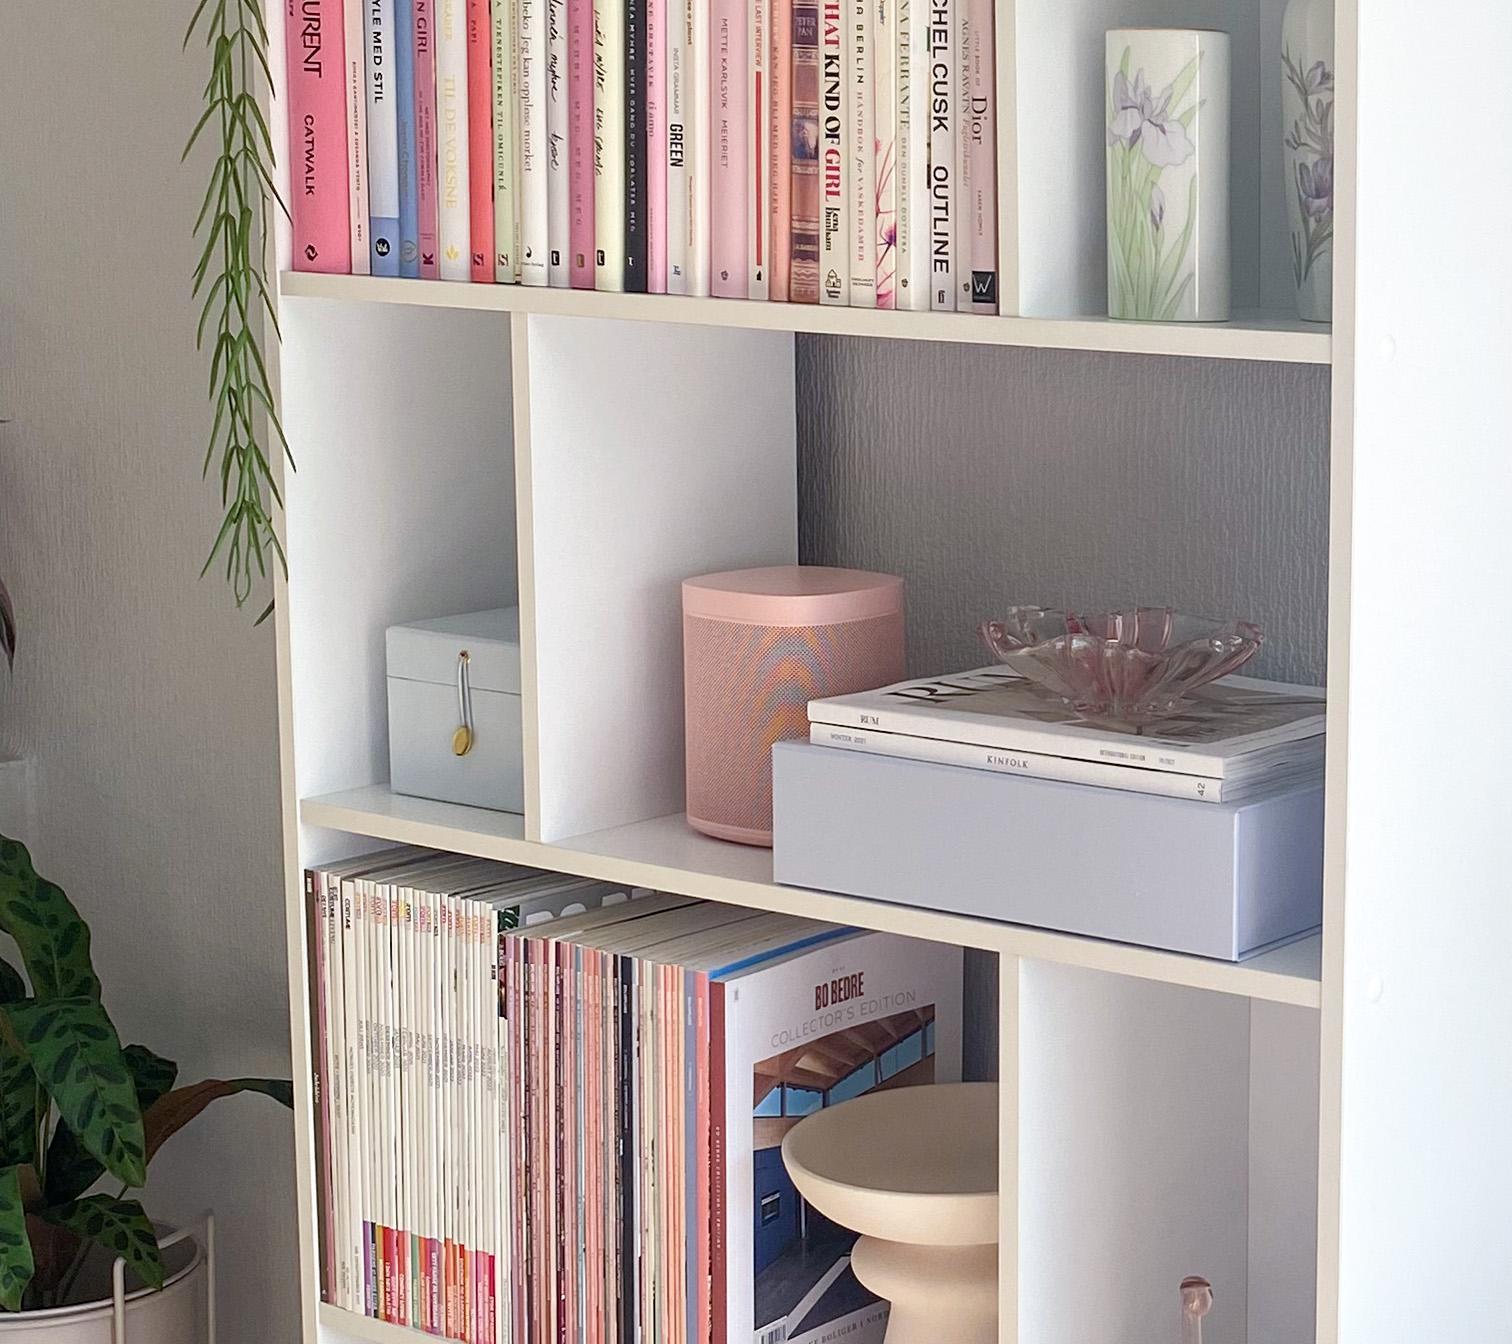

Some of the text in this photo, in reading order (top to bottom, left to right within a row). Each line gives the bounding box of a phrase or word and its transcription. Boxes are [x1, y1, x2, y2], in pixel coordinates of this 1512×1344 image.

[416, 17, 428, 58] GIRL
[686, 21, 694, 46] plant
[755, 6, 763, 26] LAST
[799, 26, 814, 37] PAN
[373, 30, 383, 66] MED
[521, 36, 533, 54] Jeg
[755, 26, 763, 67] INTERVIEW
[855, 23, 865, 84] BERLIN
[961, 18, 970, 61] AGNES
[374, 72, 384, 104] STIL
[523, 57, 533, 78] kan
[824, 53, 841, 112] KIND
[900, 31, 911, 131] FERRANTE
[961, 64, 971, 114] RAVATN
[720, 17, 729, 169] METTE KARLSVIK MEIERIET
[932, 63, 949, 133] CUSK
[630, 133, 636, 147] DU
[825, 115, 841, 146] OF
[972, 96, 989, 146] Dior
[304, 114, 316, 197] CATWALK
[669, 123, 684, 168] GREEN
[856, 156, 865, 173] for
[446, 137, 458, 209] VOKSNE
[825, 147, 842, 203] GIRL
[857, 176, 865, 261] VASKEDAMER
[932, 165, 950, 275] OUTLINE
[860, 714, 880, 726] RUM
[986, 754, 1030, 770] KINFOLK
[1196, 782, 1206, 797] 42
[815, 971, 866, 1011] BO BEDRE
[771, 991, 917, 1049] COLLECTOR'S EDITION
[821, 1323, 859, 1344] BOLIGER
